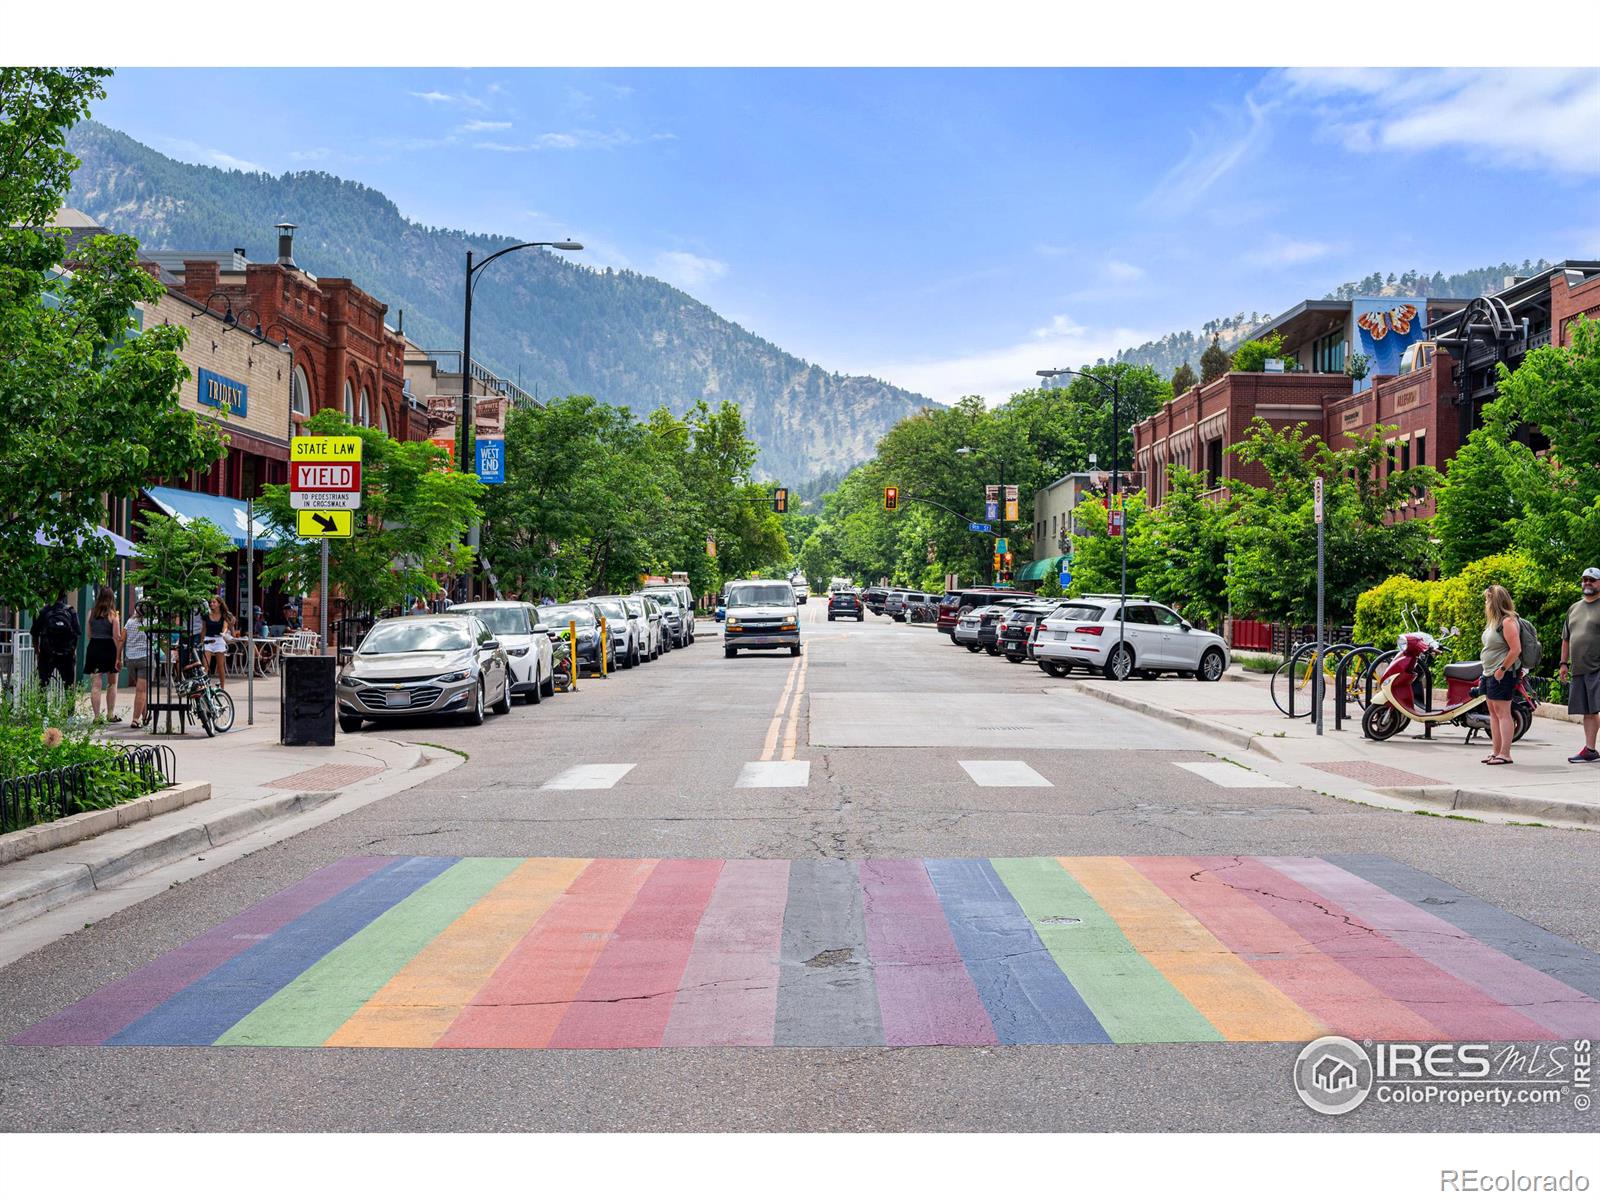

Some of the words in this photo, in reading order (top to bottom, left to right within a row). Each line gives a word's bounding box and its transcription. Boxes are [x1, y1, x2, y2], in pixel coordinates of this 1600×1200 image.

[208, 378, 242, 408] TRIDENT
[297, 443, 328, 454] STATE
[333, 443, 355, 454] LAW
[481, 448, 499, 459] WEST
[482, 459, 499, 471] END
[301, 468, 351, 486] YIELD
